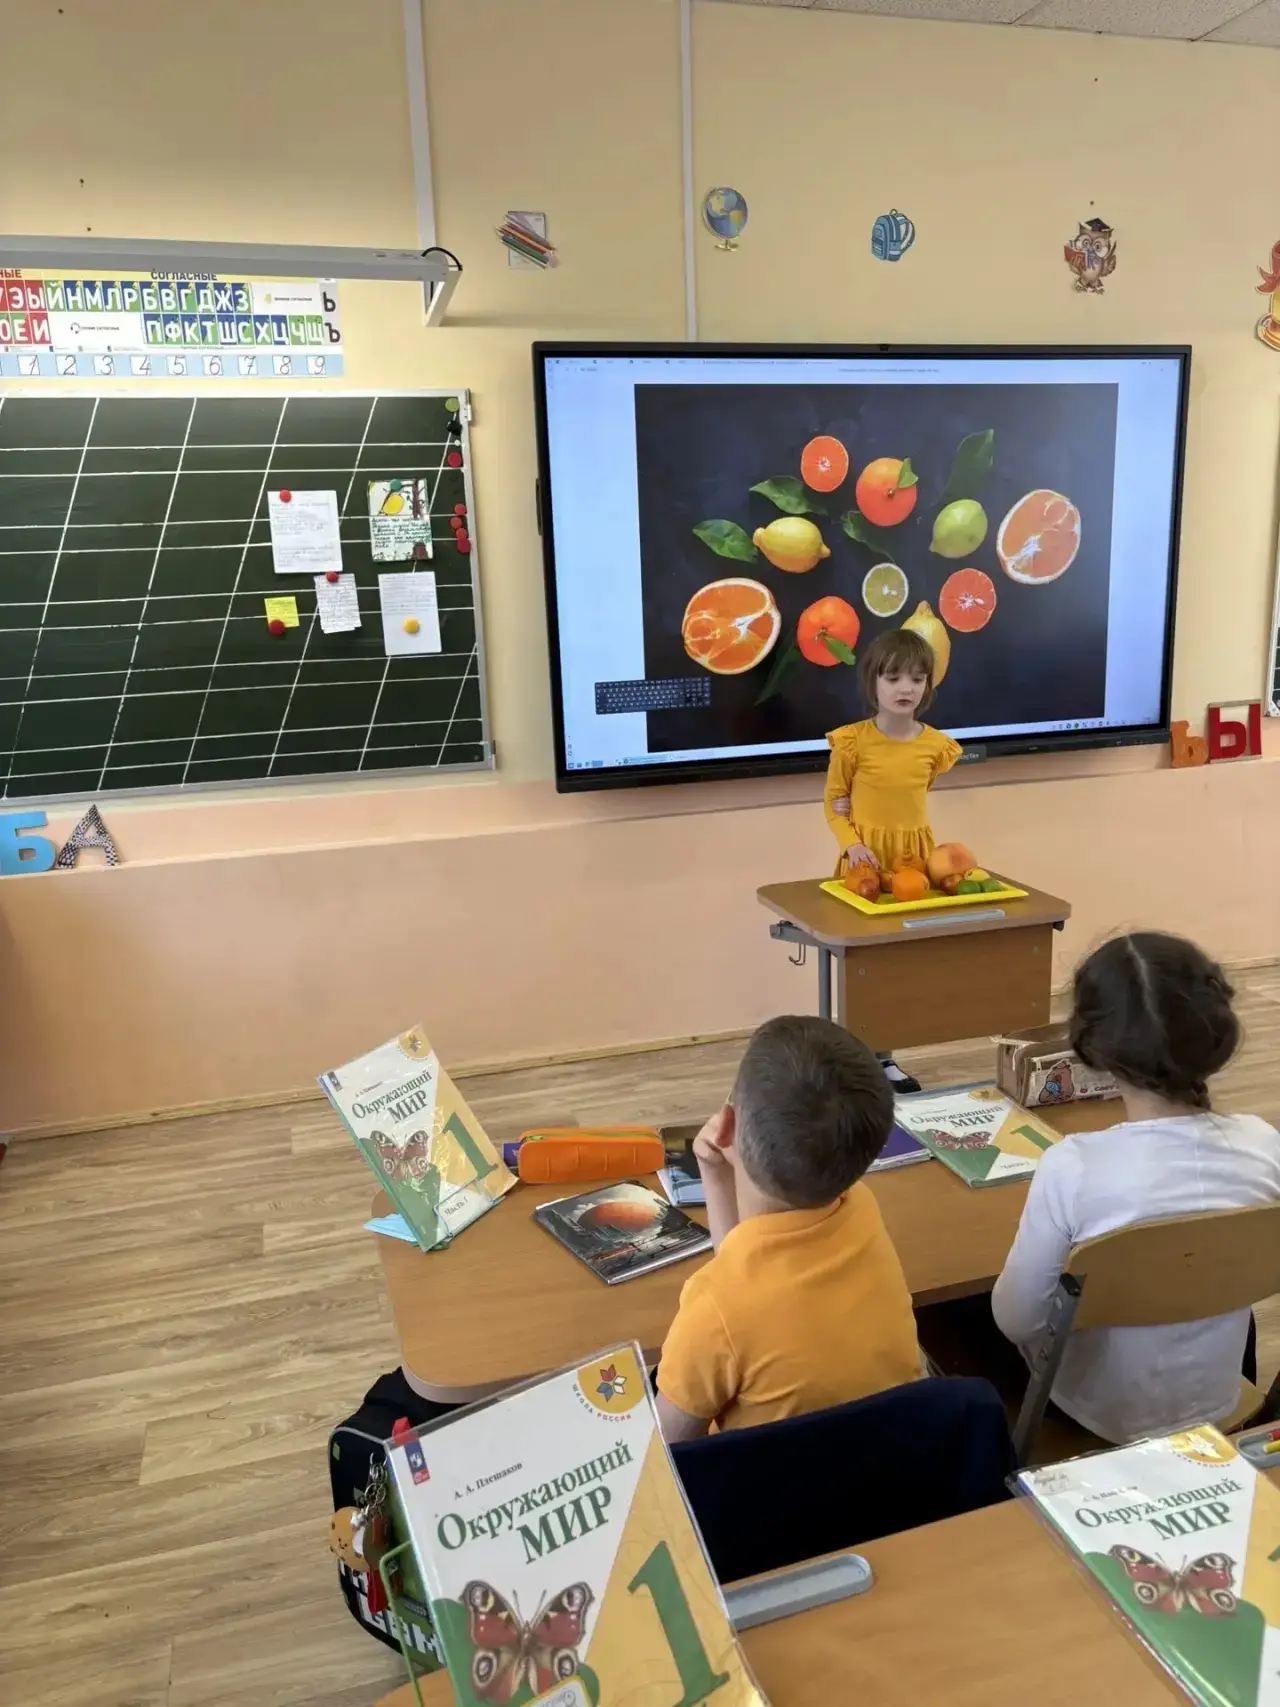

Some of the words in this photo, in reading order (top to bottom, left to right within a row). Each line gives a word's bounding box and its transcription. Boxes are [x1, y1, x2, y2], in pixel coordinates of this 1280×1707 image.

[150, 271, 218, 281] СОГЛАСНЫЕ
[28, 354, 38, 376] 1
[62, 354, 77, 376] 2
[100, 354, 114, 376] 3
[139, 355, 151, 376] 4
[172, 355, 186, 376] 5
[208, 355, 222, 376] 6
[243, 355, 257, 376] 7
[279, 355, 292, 375] 8
[314, 355, 326, 375] 9
[0, 811, 56, 875] Б
[57, 804, 119, 869] А
[351, 1069, 433, 1119] Окружающий
[387, 1089, 428, 1125] МИР
[910, 1105, 1004, 1125] Окружающий
[949, 1114, 997, 1129] МИР
[442, 1112, 499, 1182] 1
[572, 1383, 593, 1414] ШКОЛА
[597, 1411, 632, 1422] РОССИИ
[437, 1439, 634, 1551] Окружающий
[476, 1462, 524, 1490] Плешаков
[1075, 1476, 1245, 1528] Окружающий
[1148, 1501, 1234, 1541] МИР
[515, 1485, 612, 1566] МИР
[627, 1540, 731, 1707] 1
